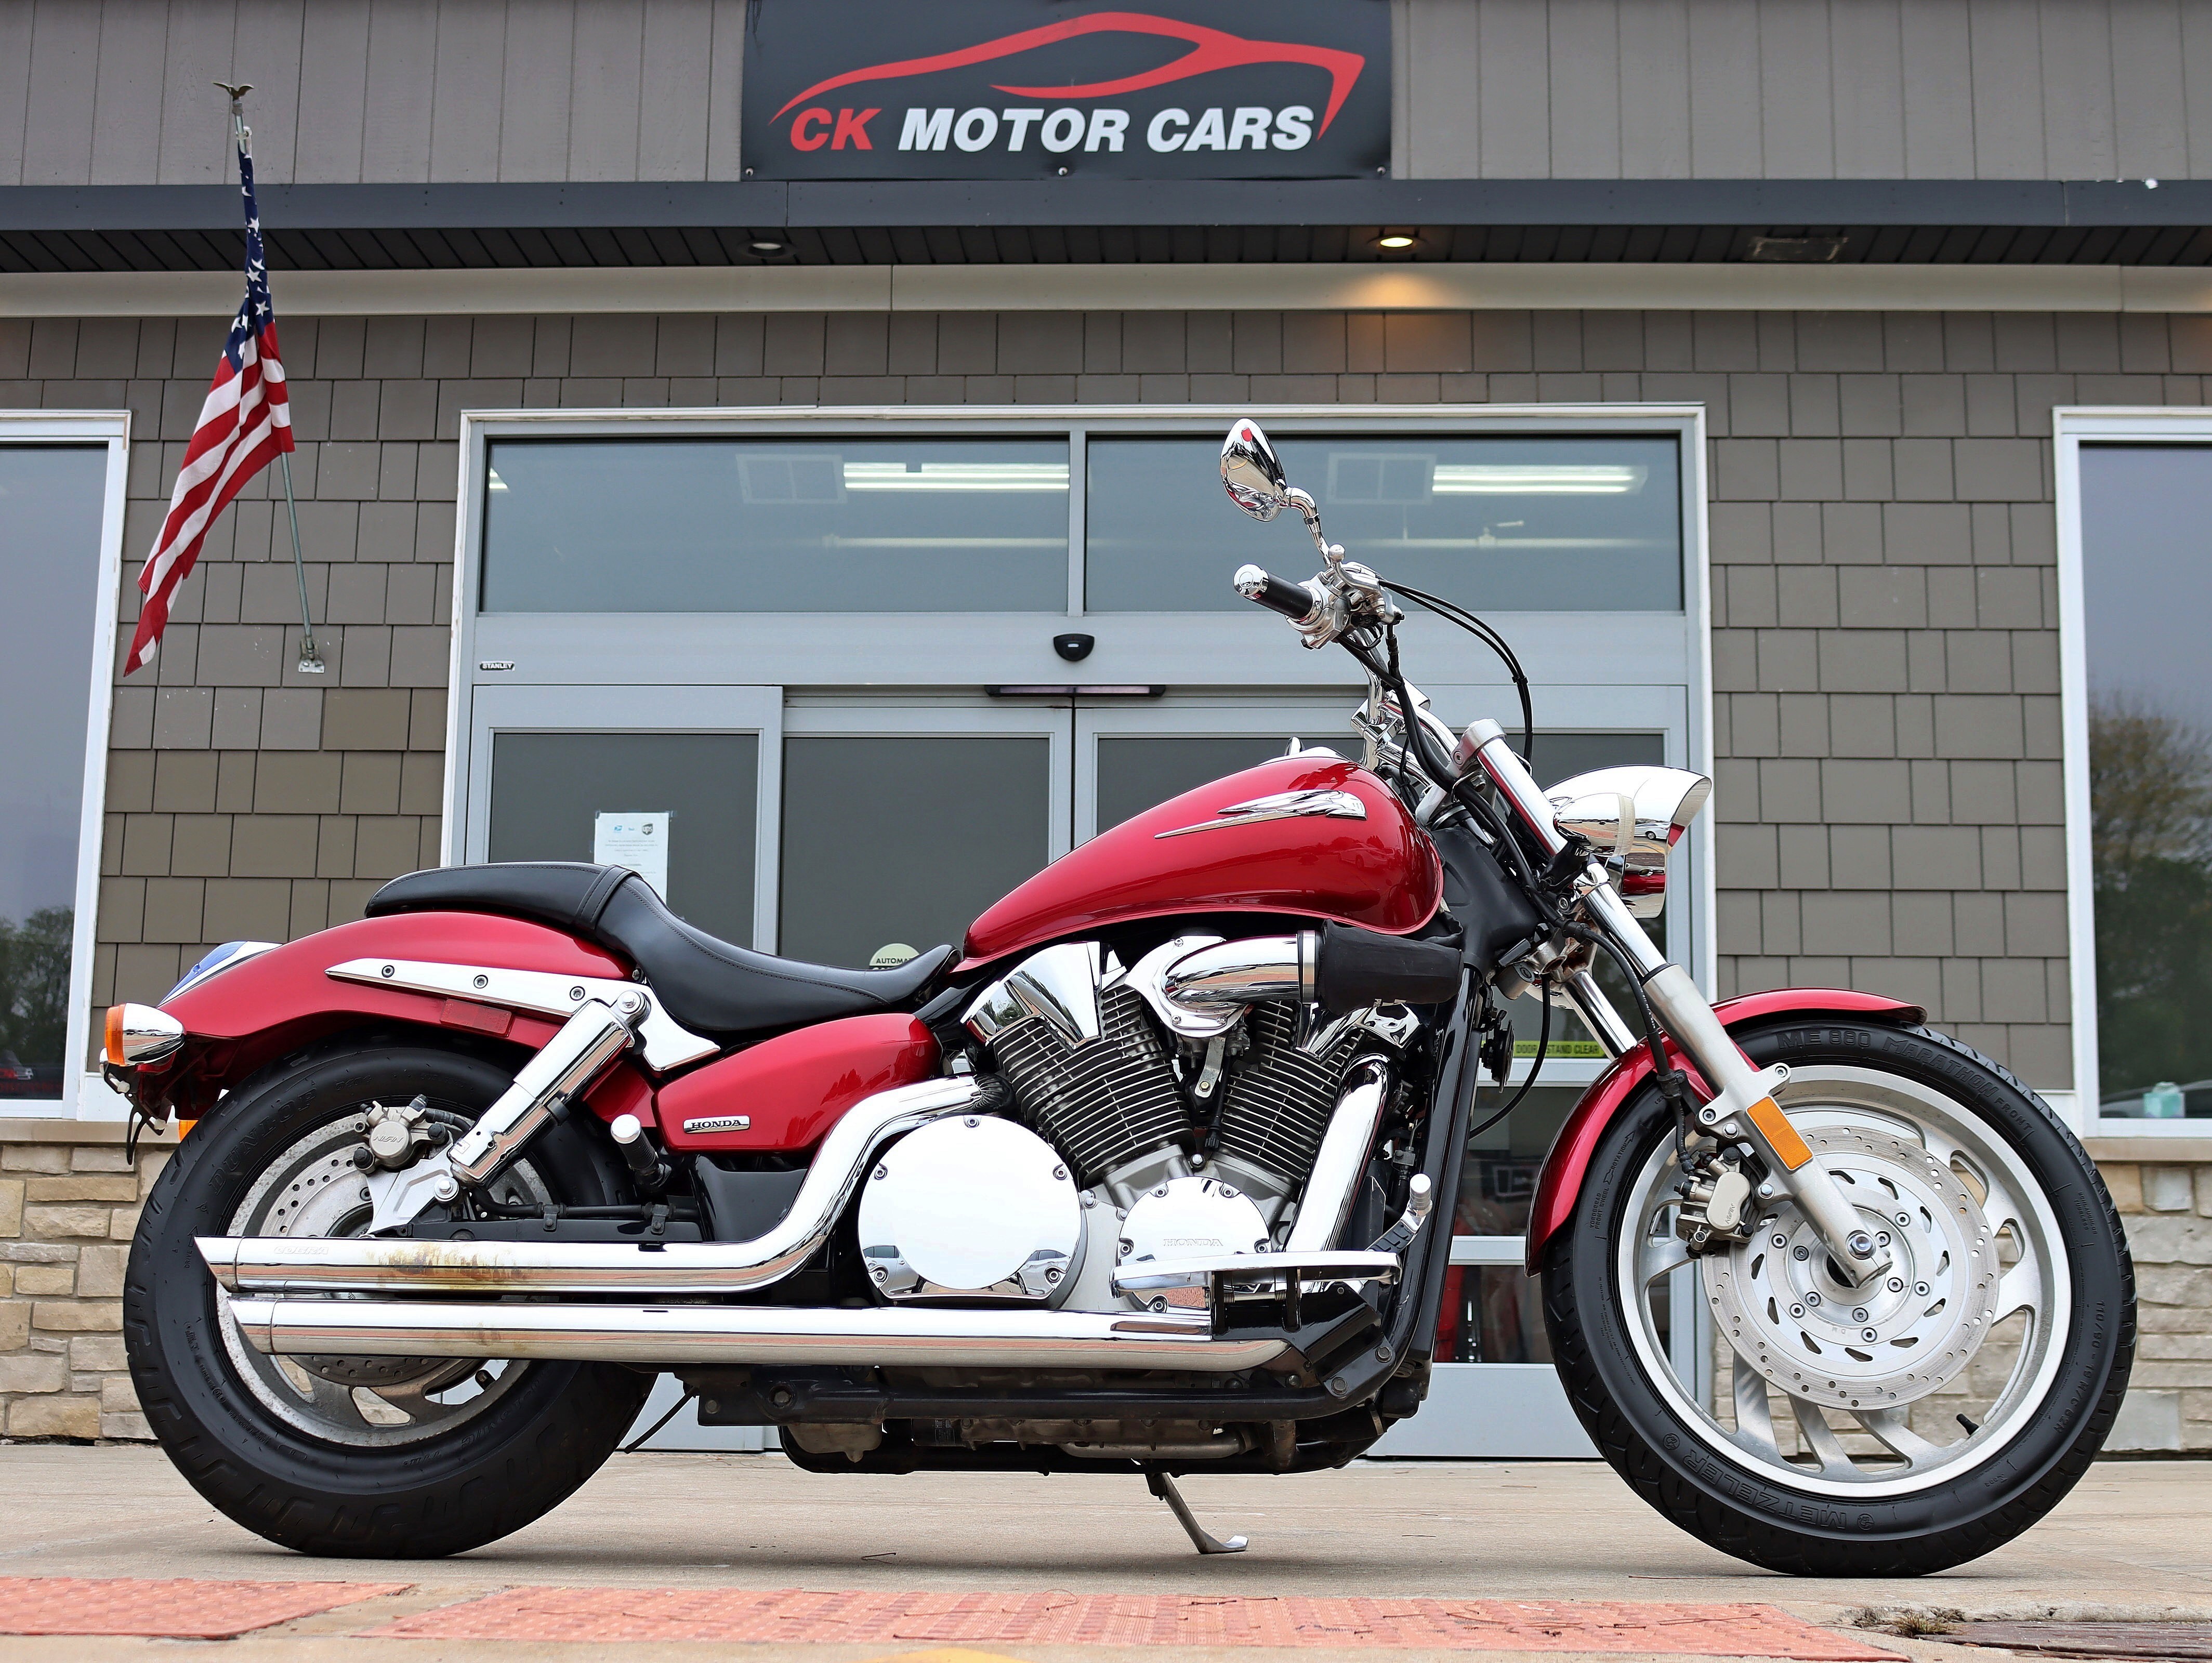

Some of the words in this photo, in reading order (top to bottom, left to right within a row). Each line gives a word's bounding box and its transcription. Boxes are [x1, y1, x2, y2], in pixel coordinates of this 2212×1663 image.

[788, 108, 883, 151] CK
[898, 107, 1130, 152] MOTOR
[1146, 105, 1314, 152] CARS
[1776, 1031, 1822, 1049] ME
[1828, 1030, 1871, 1048] 880
[1882, 1036, 2000, 1098] MARATHON
[691, 1119, 742, 1129] HONDA
[274, 1246, 329, 1255] COBRA
[1163, 1238, 1223, 1247] HONDA
[185, 1249, 193, 1269] DRIVE
[1682, 1449, 1847, 1530] METZELER
